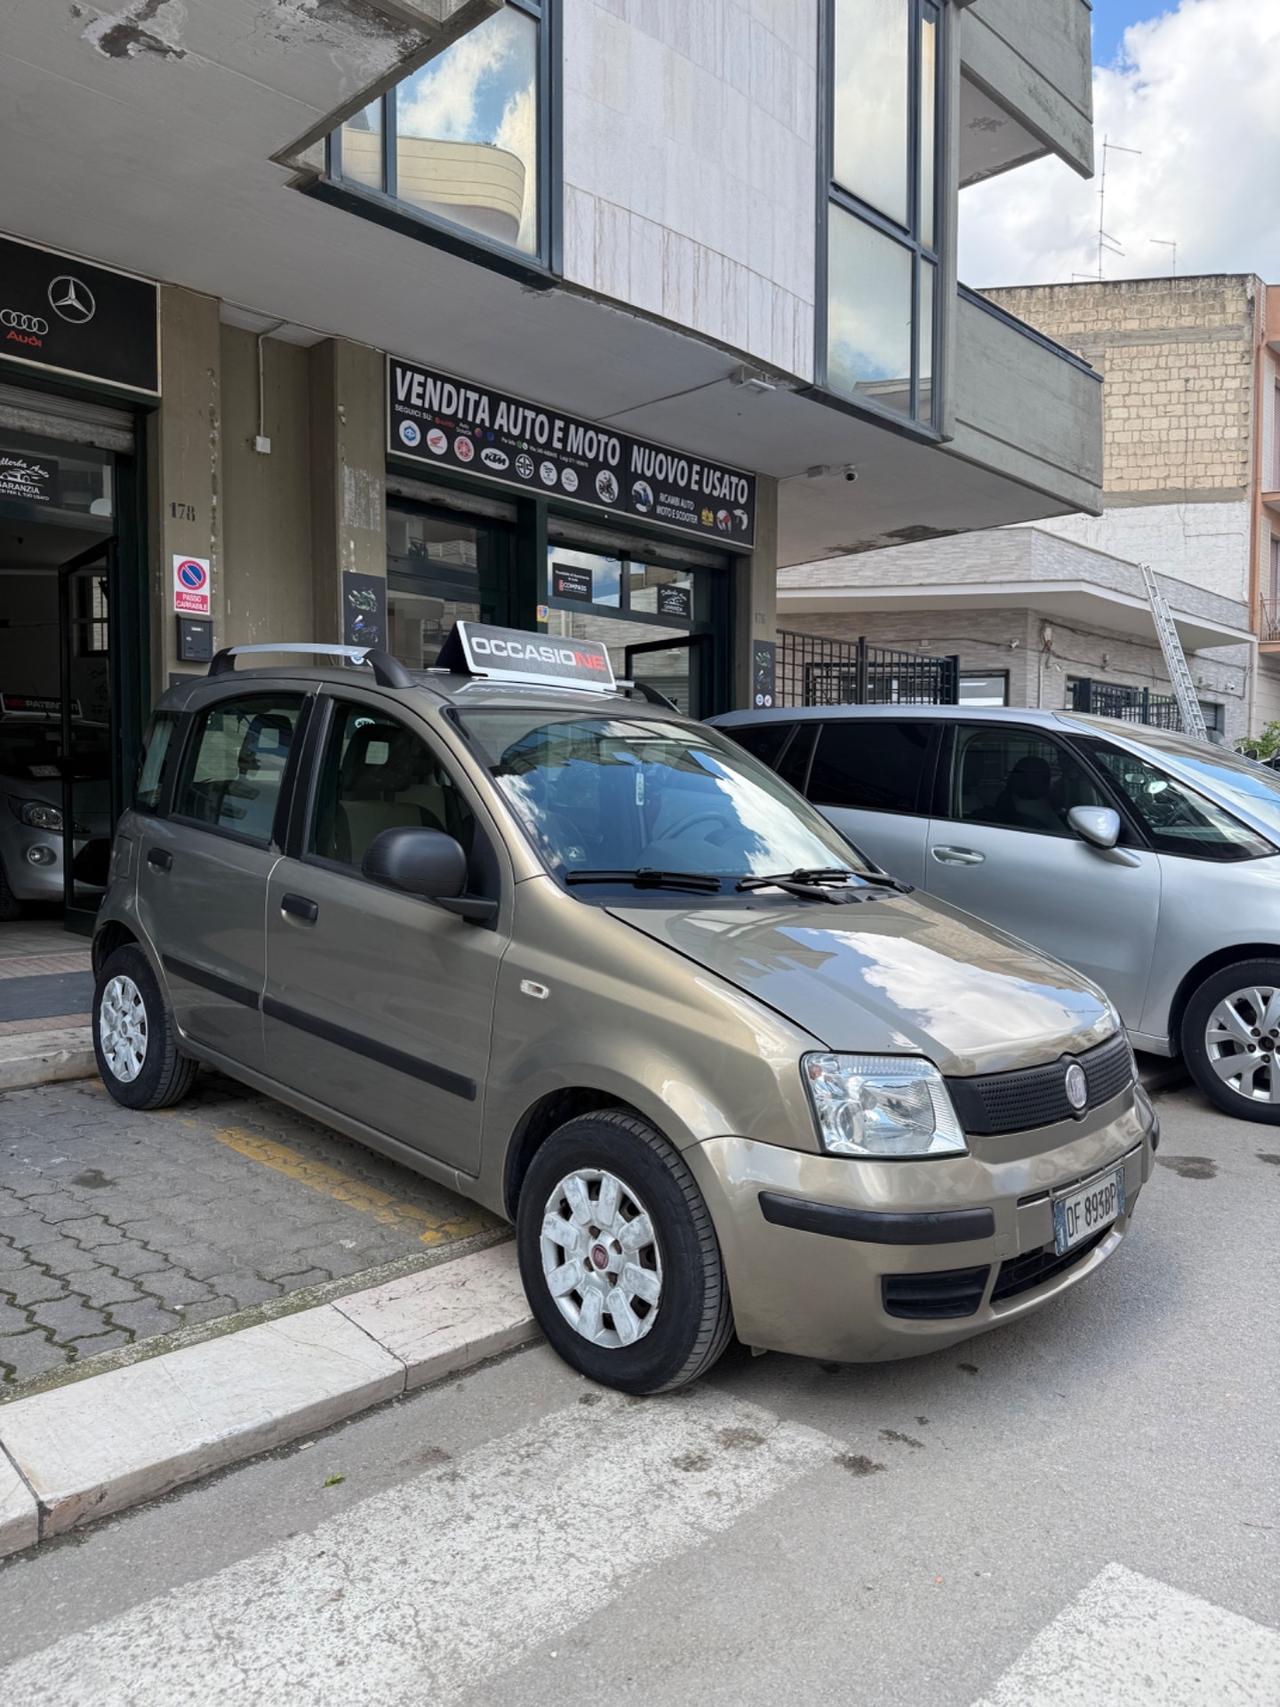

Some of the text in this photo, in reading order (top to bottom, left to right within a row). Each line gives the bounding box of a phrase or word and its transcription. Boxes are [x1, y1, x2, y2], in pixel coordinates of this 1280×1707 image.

[6, 331, 42, 347] Audi
[395, 404, 421, 417] SEGUICI
[396, 367, 490, 427] VENDITA
[494, 401, 549, 444] AUTO
[552, 419, 564, 450] E
[566, 424, 620, 466] MOTO
[630, 444, 688, 487] NUOVO
[690, 463, 700, 491] E
[702, 467, 748, 504] USATO
[484, 453, 508, 467] KTM
[171, 502, 195, 522] 178
[176, 600, 208, 610] CARRABILE
[182, 593, 202, 602] PASSO
[471, 637, 606, 670] OCCASIONE
[1067, 1183, 1116, 1238] DF 893BP
